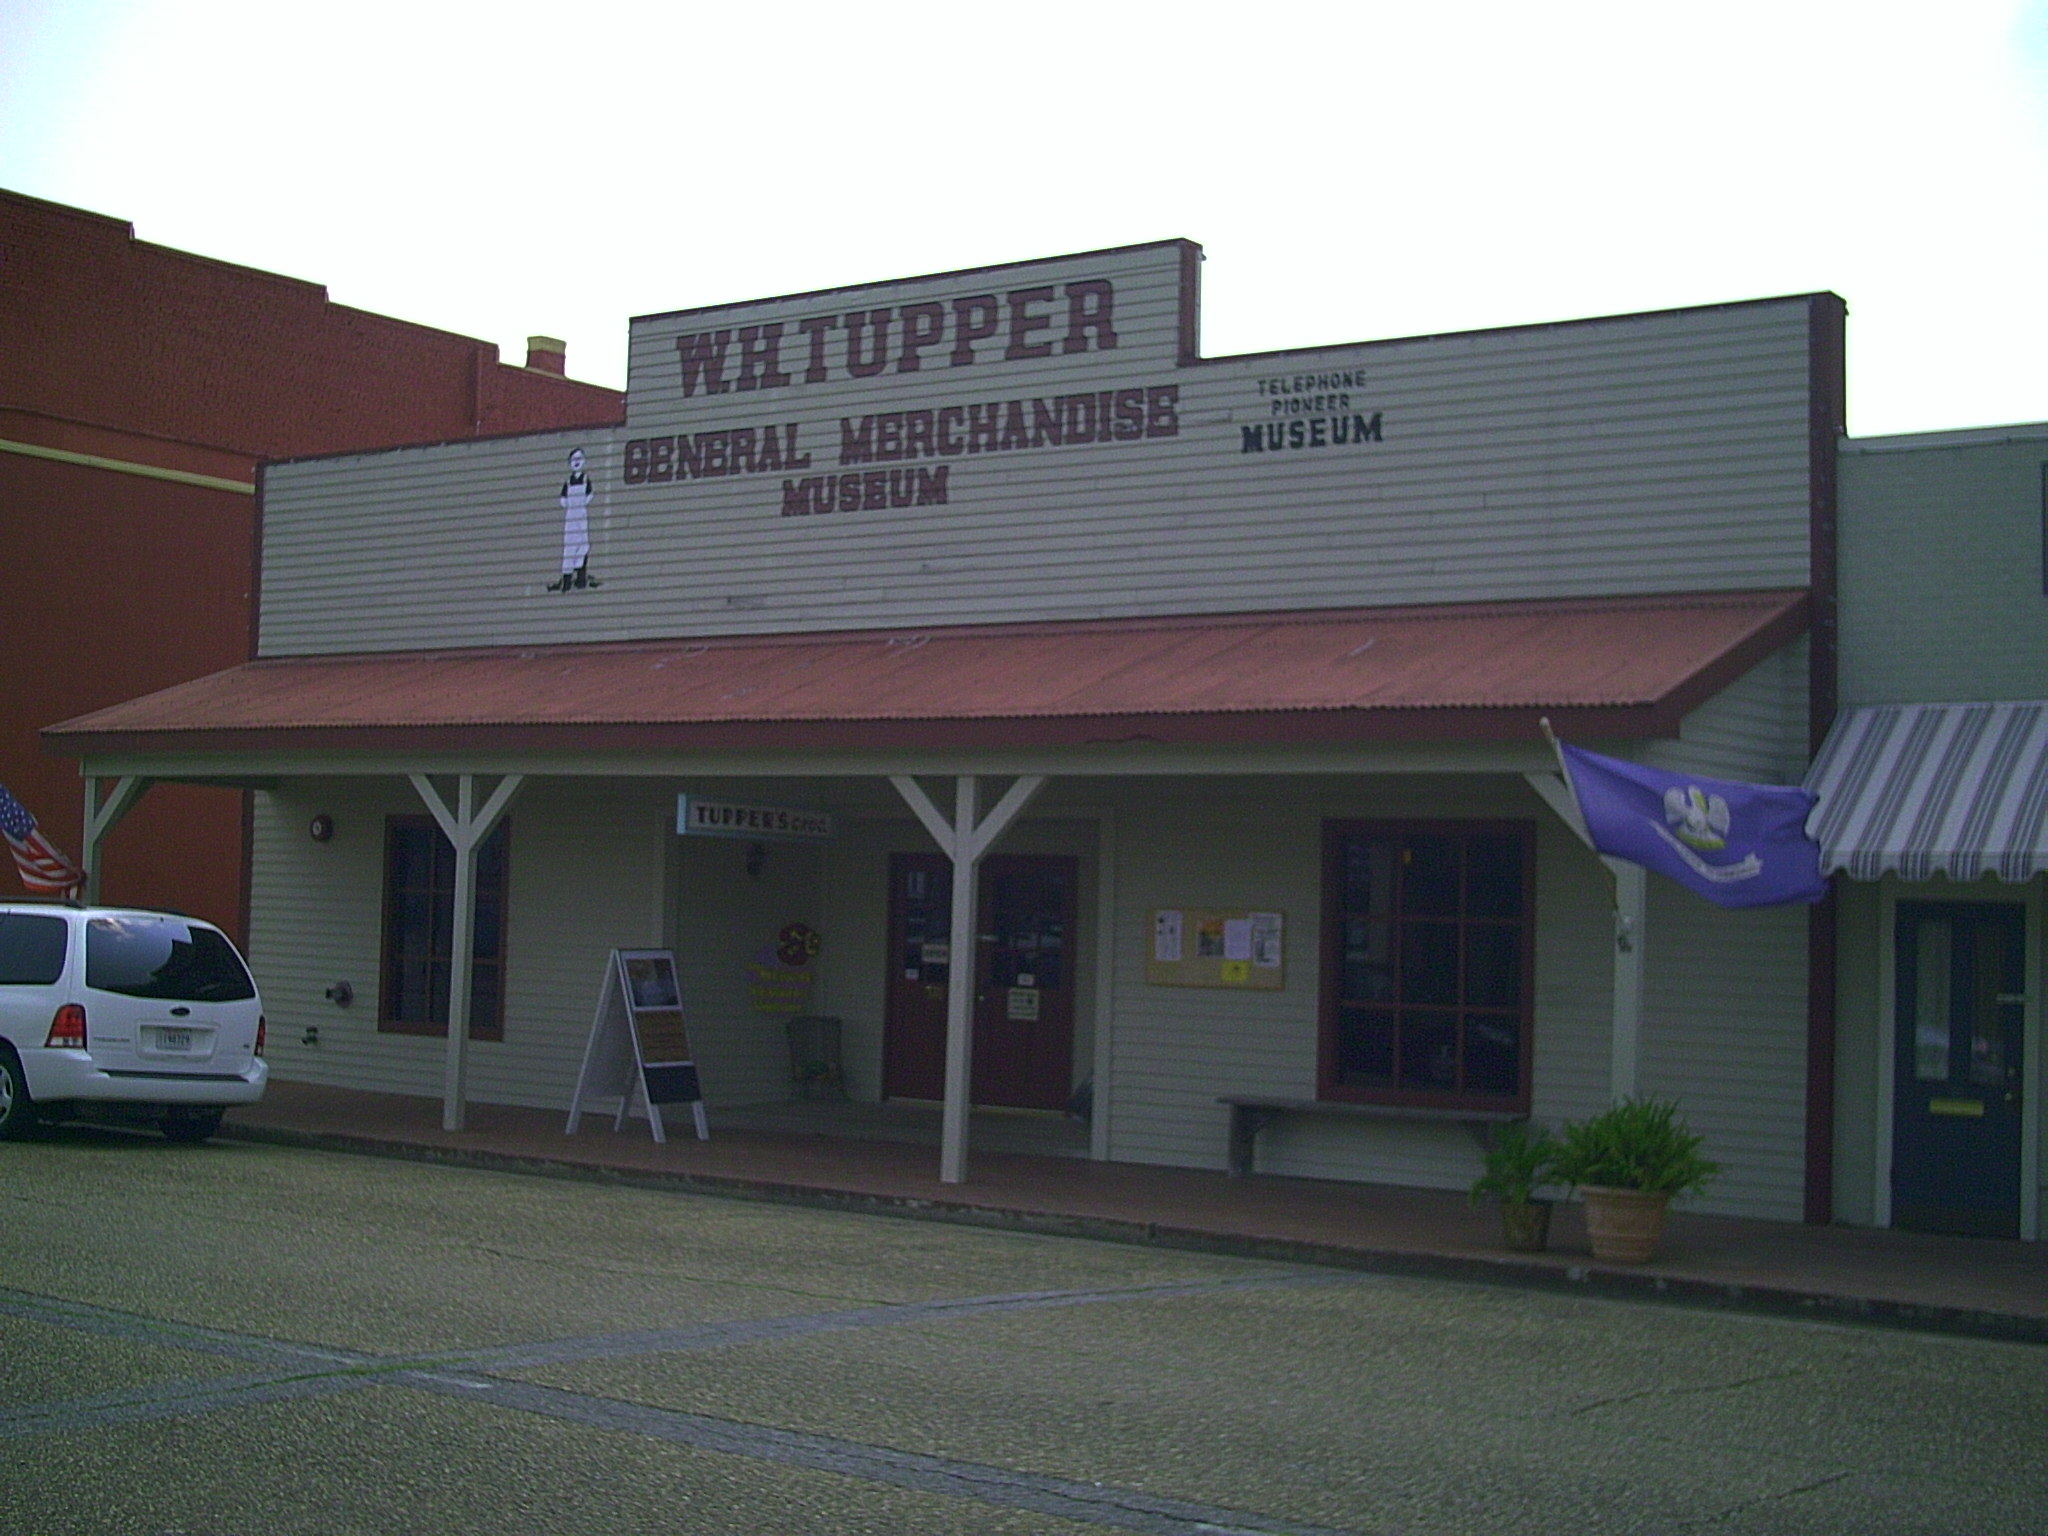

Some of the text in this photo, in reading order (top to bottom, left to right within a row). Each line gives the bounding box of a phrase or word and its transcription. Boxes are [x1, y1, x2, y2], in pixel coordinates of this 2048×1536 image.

[800, 278, 1118, 384] TUPPER
[1257, 370, 1367, 396] TELEPHONE
[1271, 393, 1351, 416] PIONEER
[623, 385, 1180, 484] GENERAL MERCHANDISE
[1240, 412, 1384, 454] MUSEUM
[781, 466, 951, 517] MUSEUM
